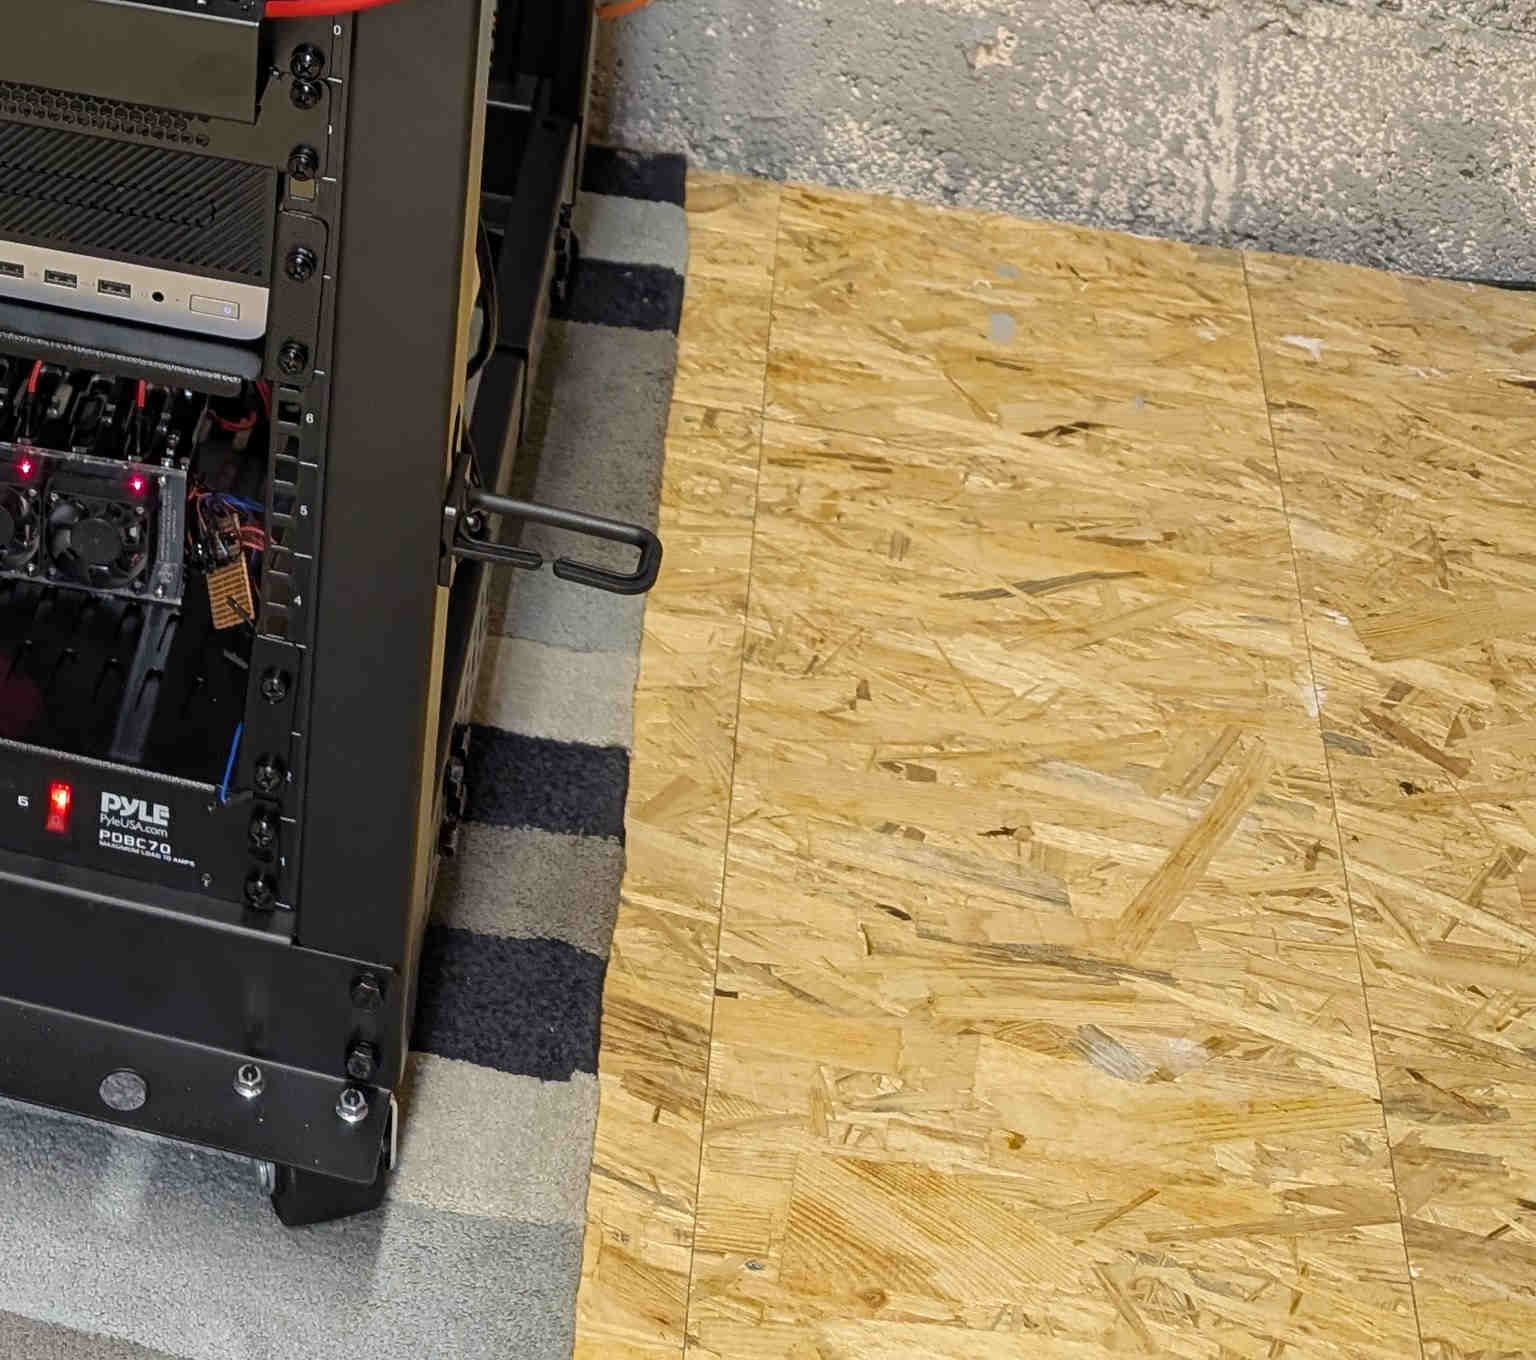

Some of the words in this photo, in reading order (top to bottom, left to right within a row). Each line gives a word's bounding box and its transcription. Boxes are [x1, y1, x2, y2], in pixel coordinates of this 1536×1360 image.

[17, 794, 29, 808] 6
[100, 791, 170, 827] PYLE
[99, 812, 169, 839] PyleUSA.com
[98, 829, 171, 856] PDBC70
